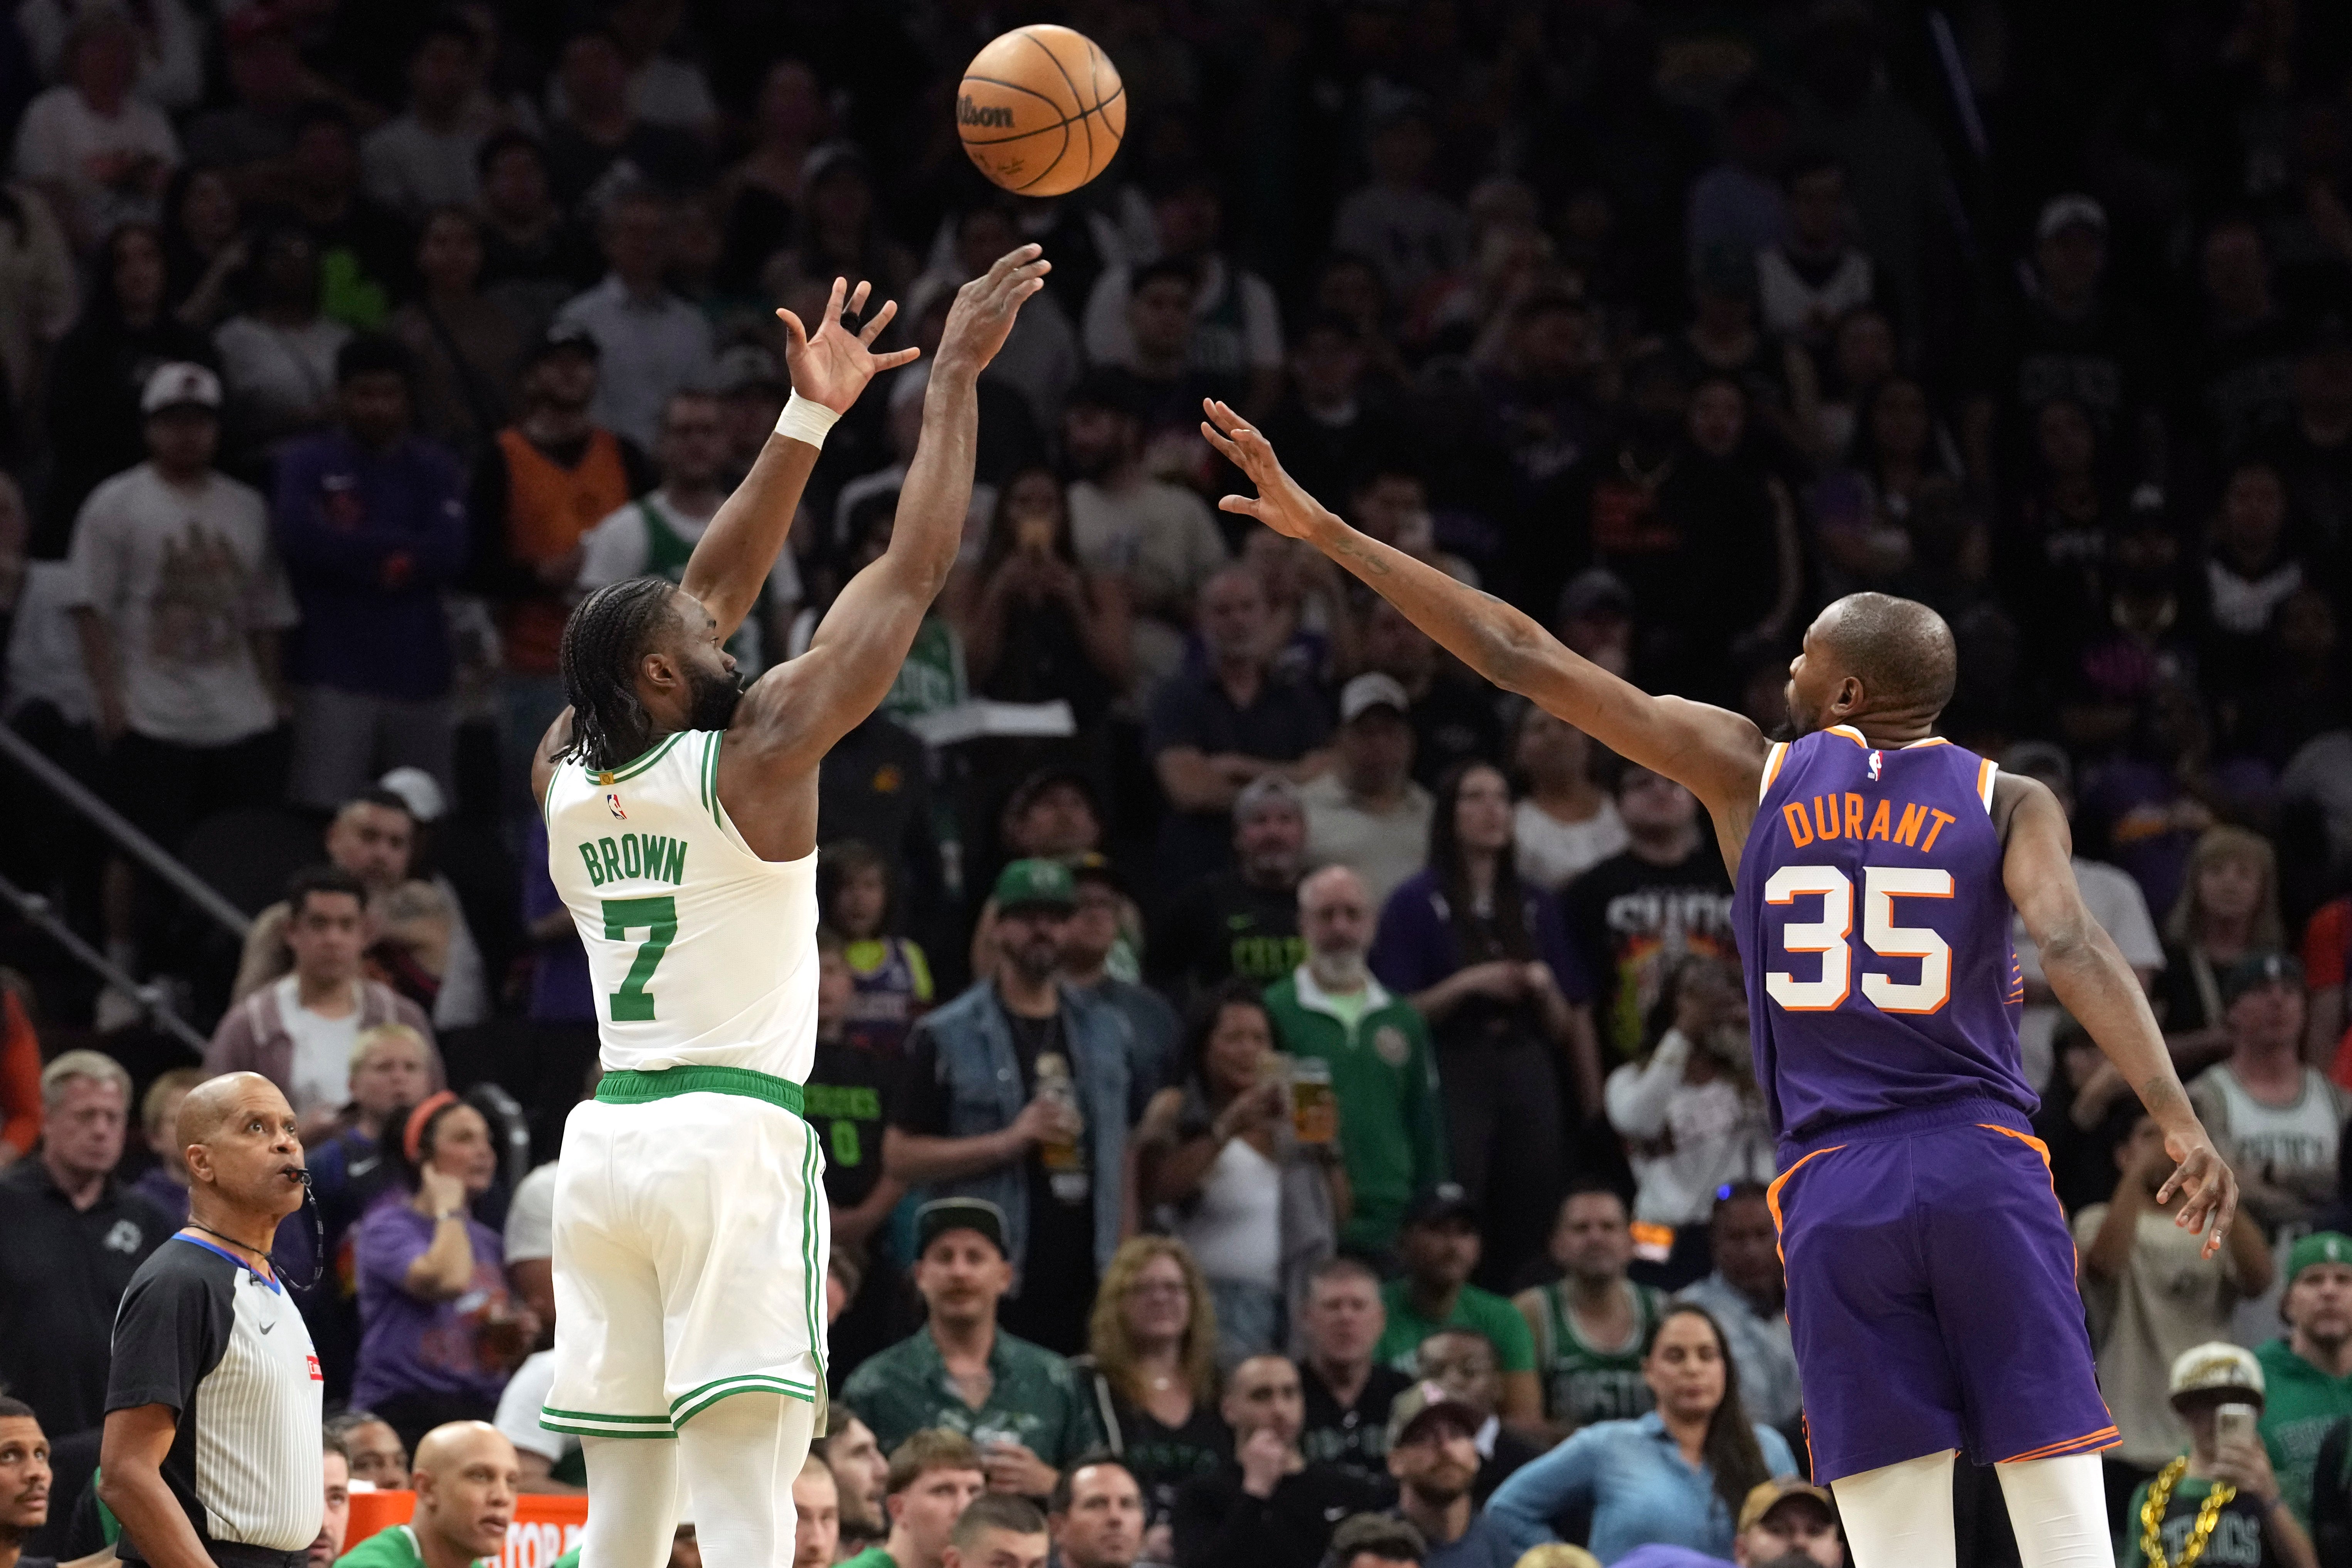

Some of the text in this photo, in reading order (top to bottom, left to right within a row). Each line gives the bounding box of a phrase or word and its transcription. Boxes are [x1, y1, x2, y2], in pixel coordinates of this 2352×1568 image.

[956, 94, 1014, 128] ilson
[1782, 792, 1956, 853] DURANT
[579, 833, 688, 887] BROWN
[601, 896, 678, 1021] 7
[1765, 865, 1955, 1015] 35
